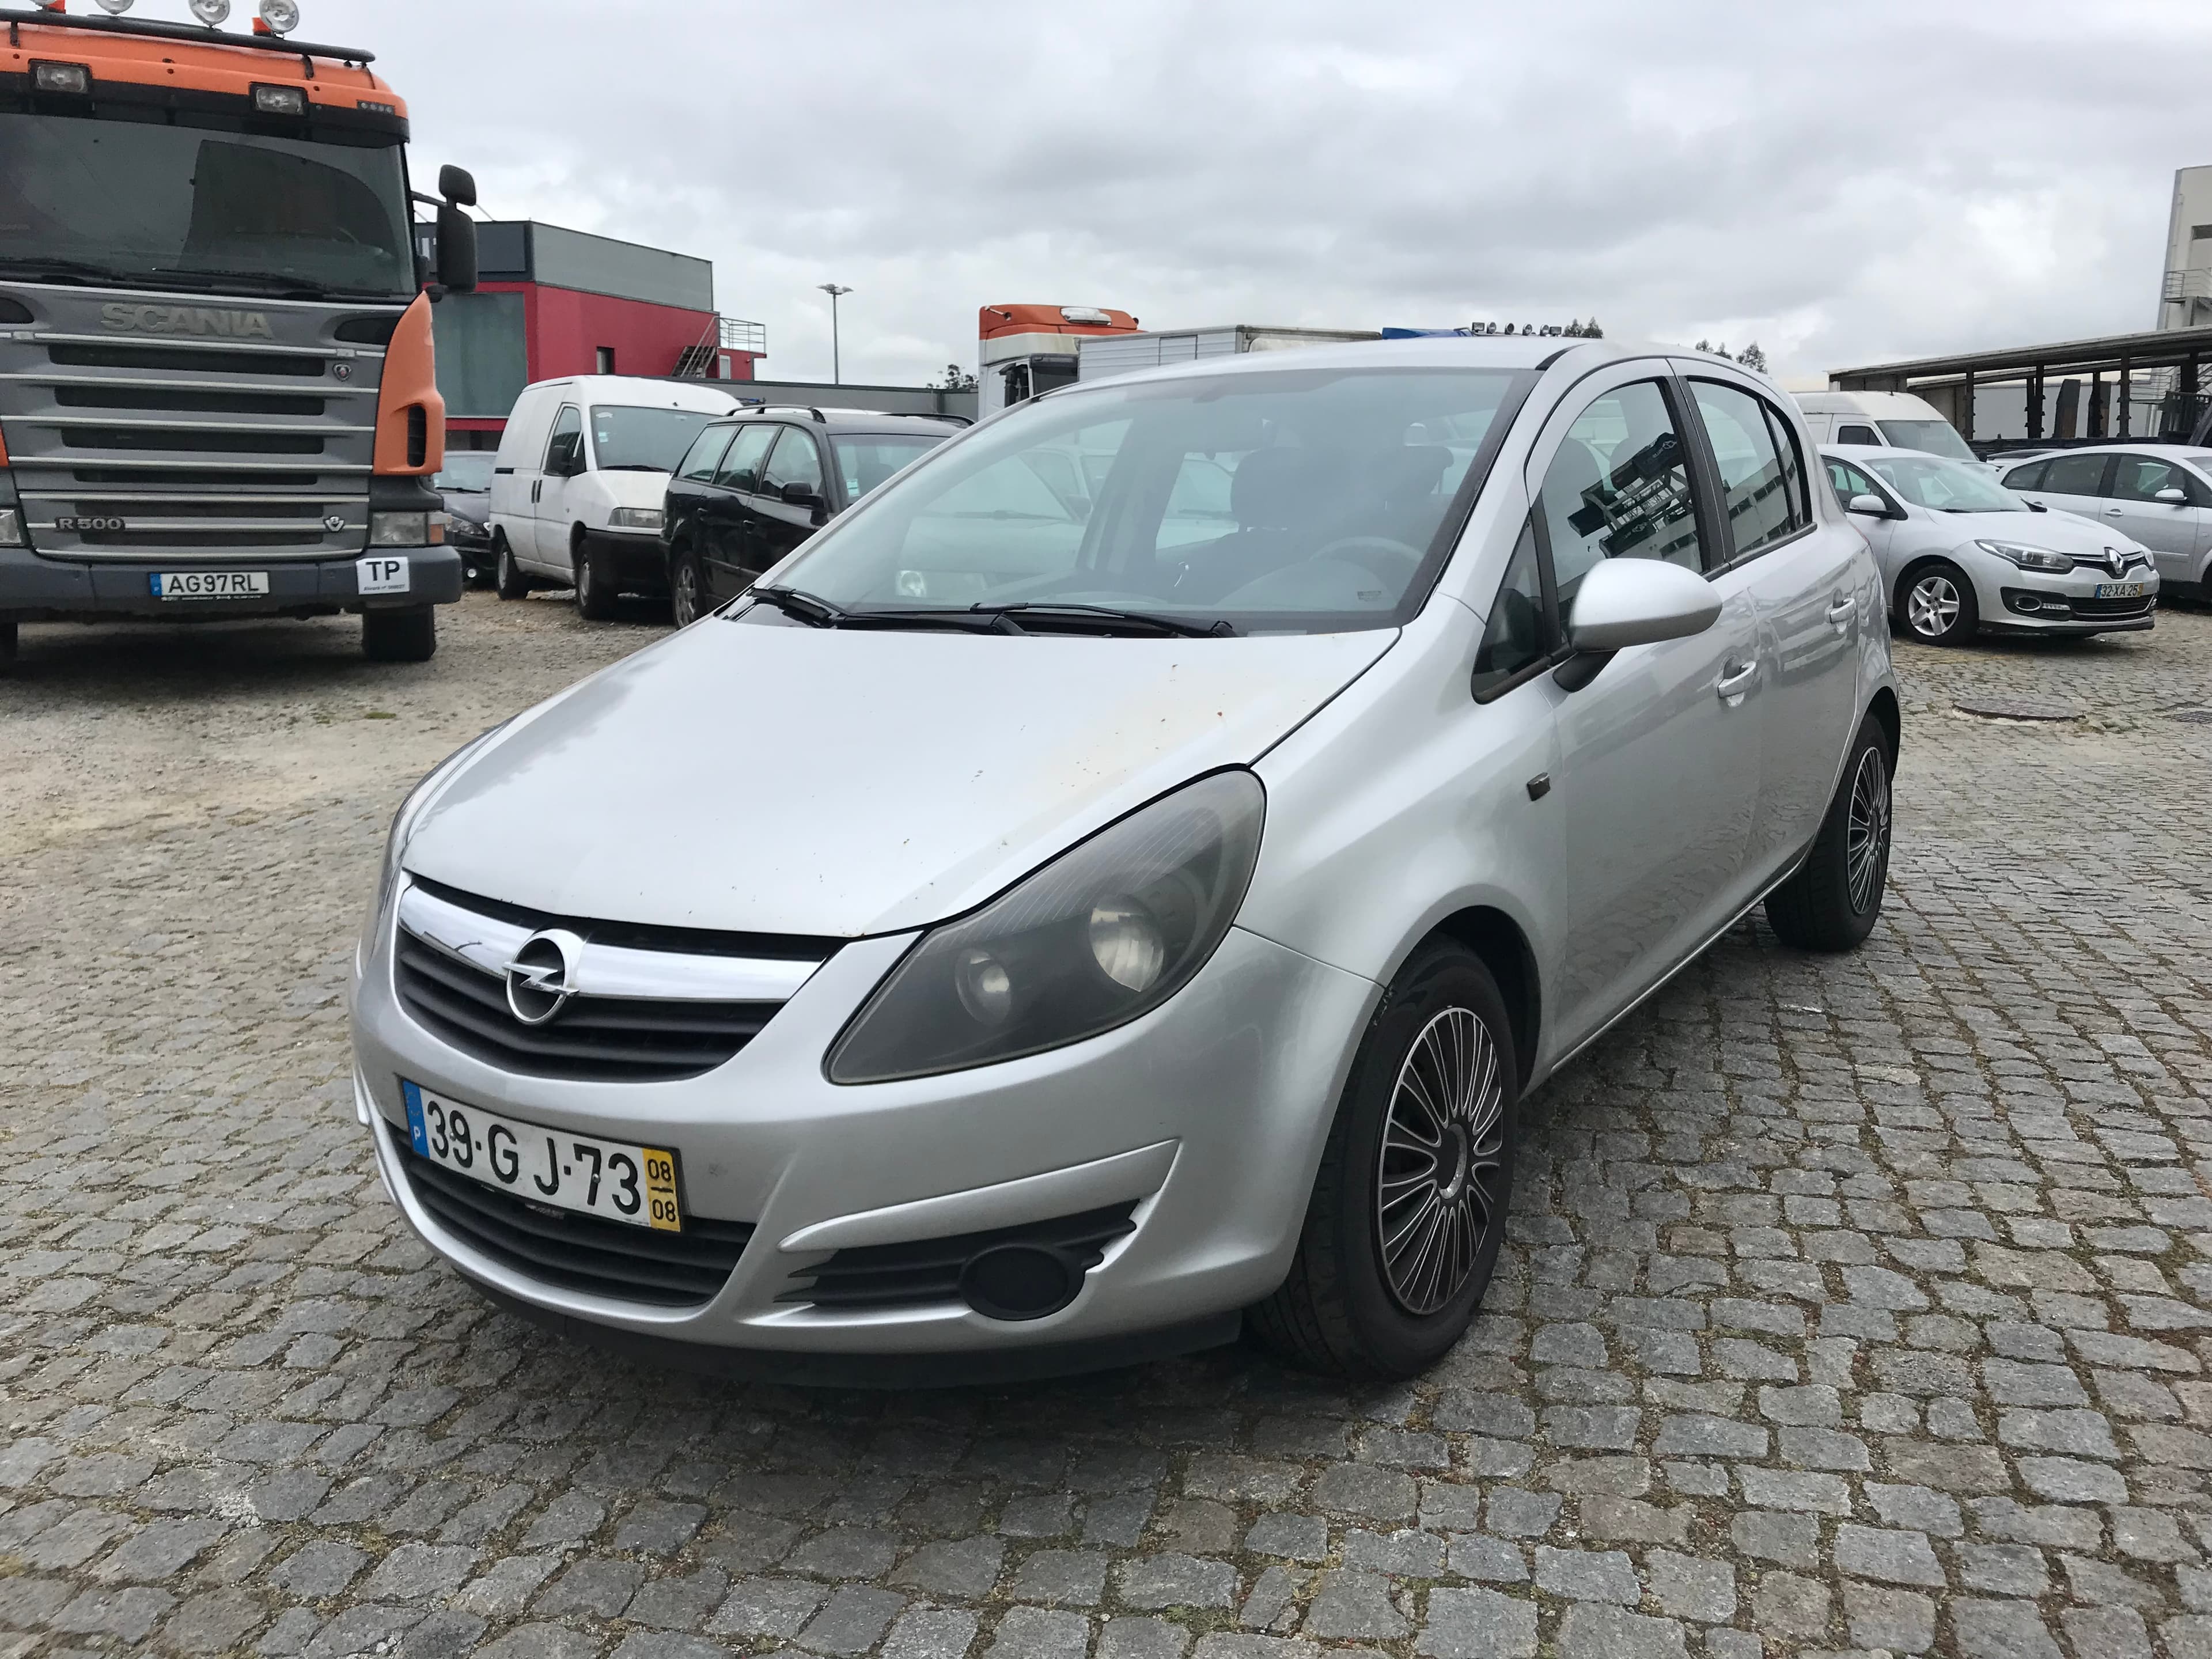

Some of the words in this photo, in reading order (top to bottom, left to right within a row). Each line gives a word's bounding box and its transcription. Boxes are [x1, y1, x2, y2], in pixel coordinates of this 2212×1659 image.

[101, 302, 274, 339] SCANIA
[365, 560, 400, 581] TP
[412, 1126, 422, 1141] P
[647, 1158, 672, 1182] 08
[652, 1199, 676, 1223] 08
